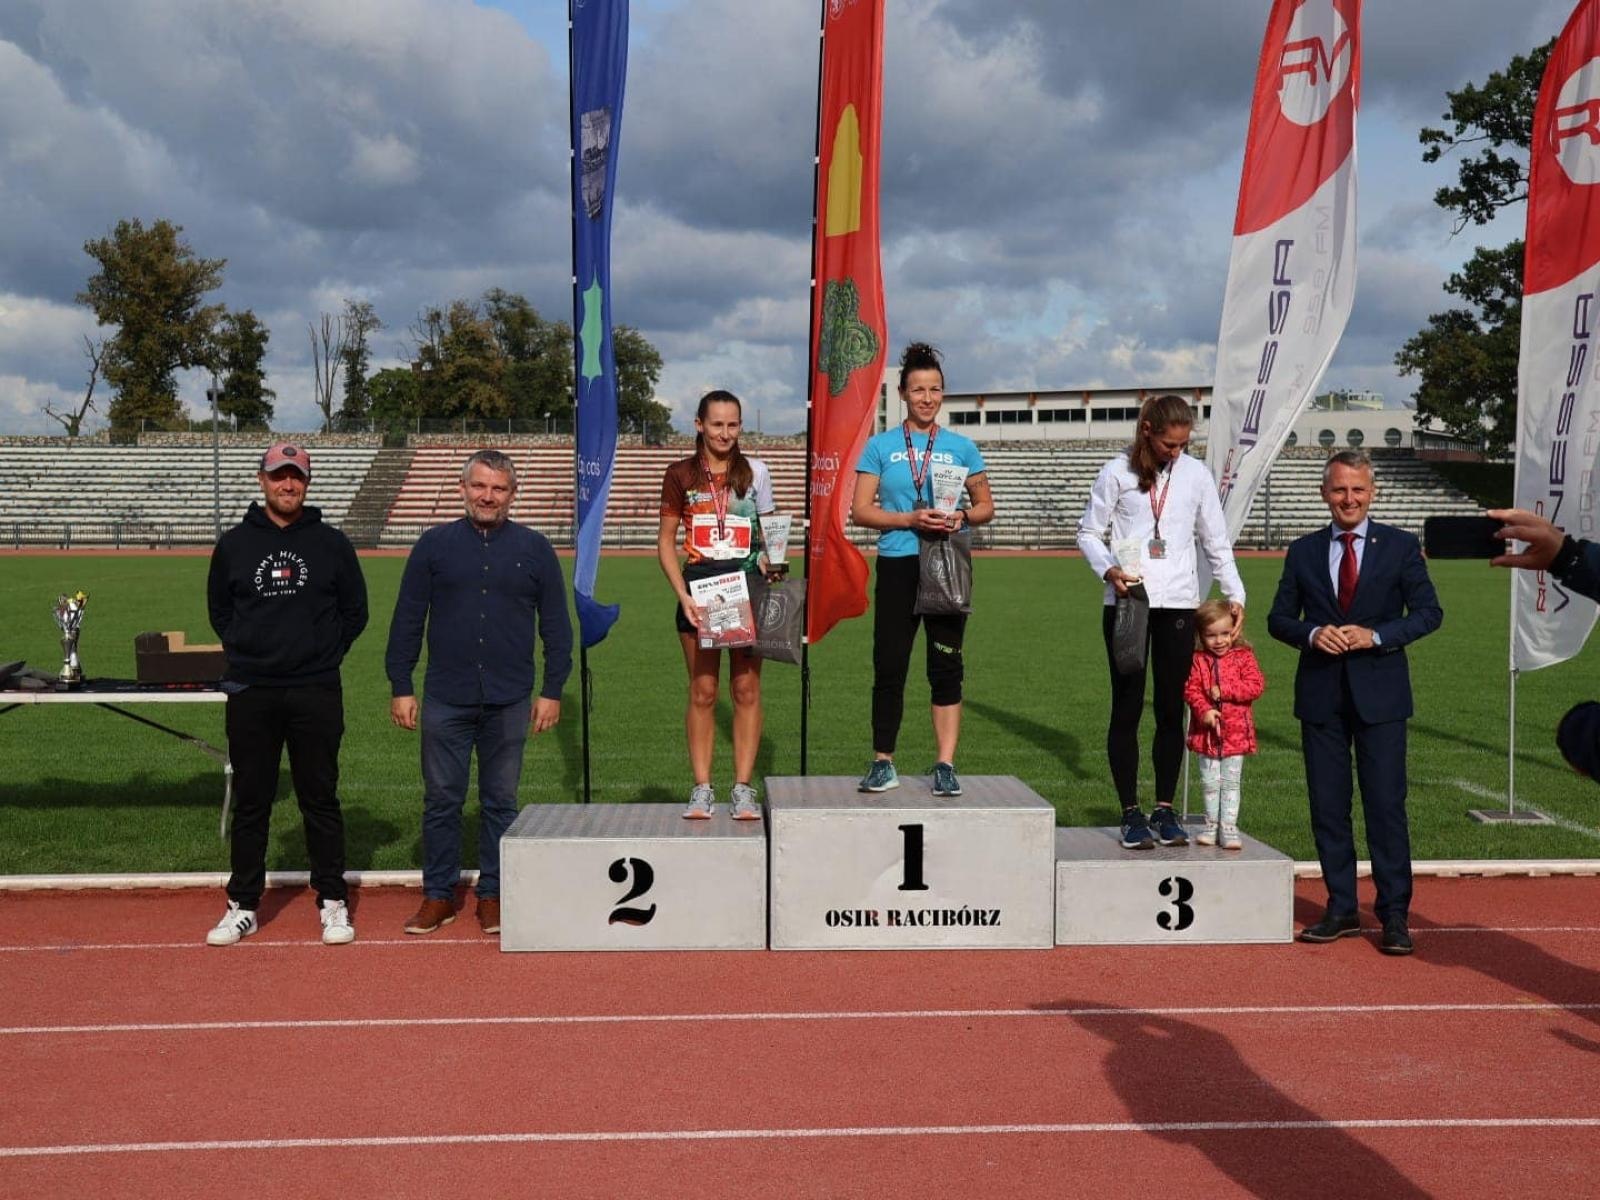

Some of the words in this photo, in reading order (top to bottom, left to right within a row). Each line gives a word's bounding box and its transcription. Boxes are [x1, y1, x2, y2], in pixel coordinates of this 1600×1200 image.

[1549, 293, 1595, 613] VNESSA
[254, 554, 274, 592] TOMMY
[280, 550, 308, 587] HILFIGER
[898, 824, 929, 891] 1
[608, 857, 656, 926] 2
[825, 910, 880, 927] OSIR
[887, 905, 1001, 927] RACIBÓRZ
[1156, 876, 1194, 931] 3
